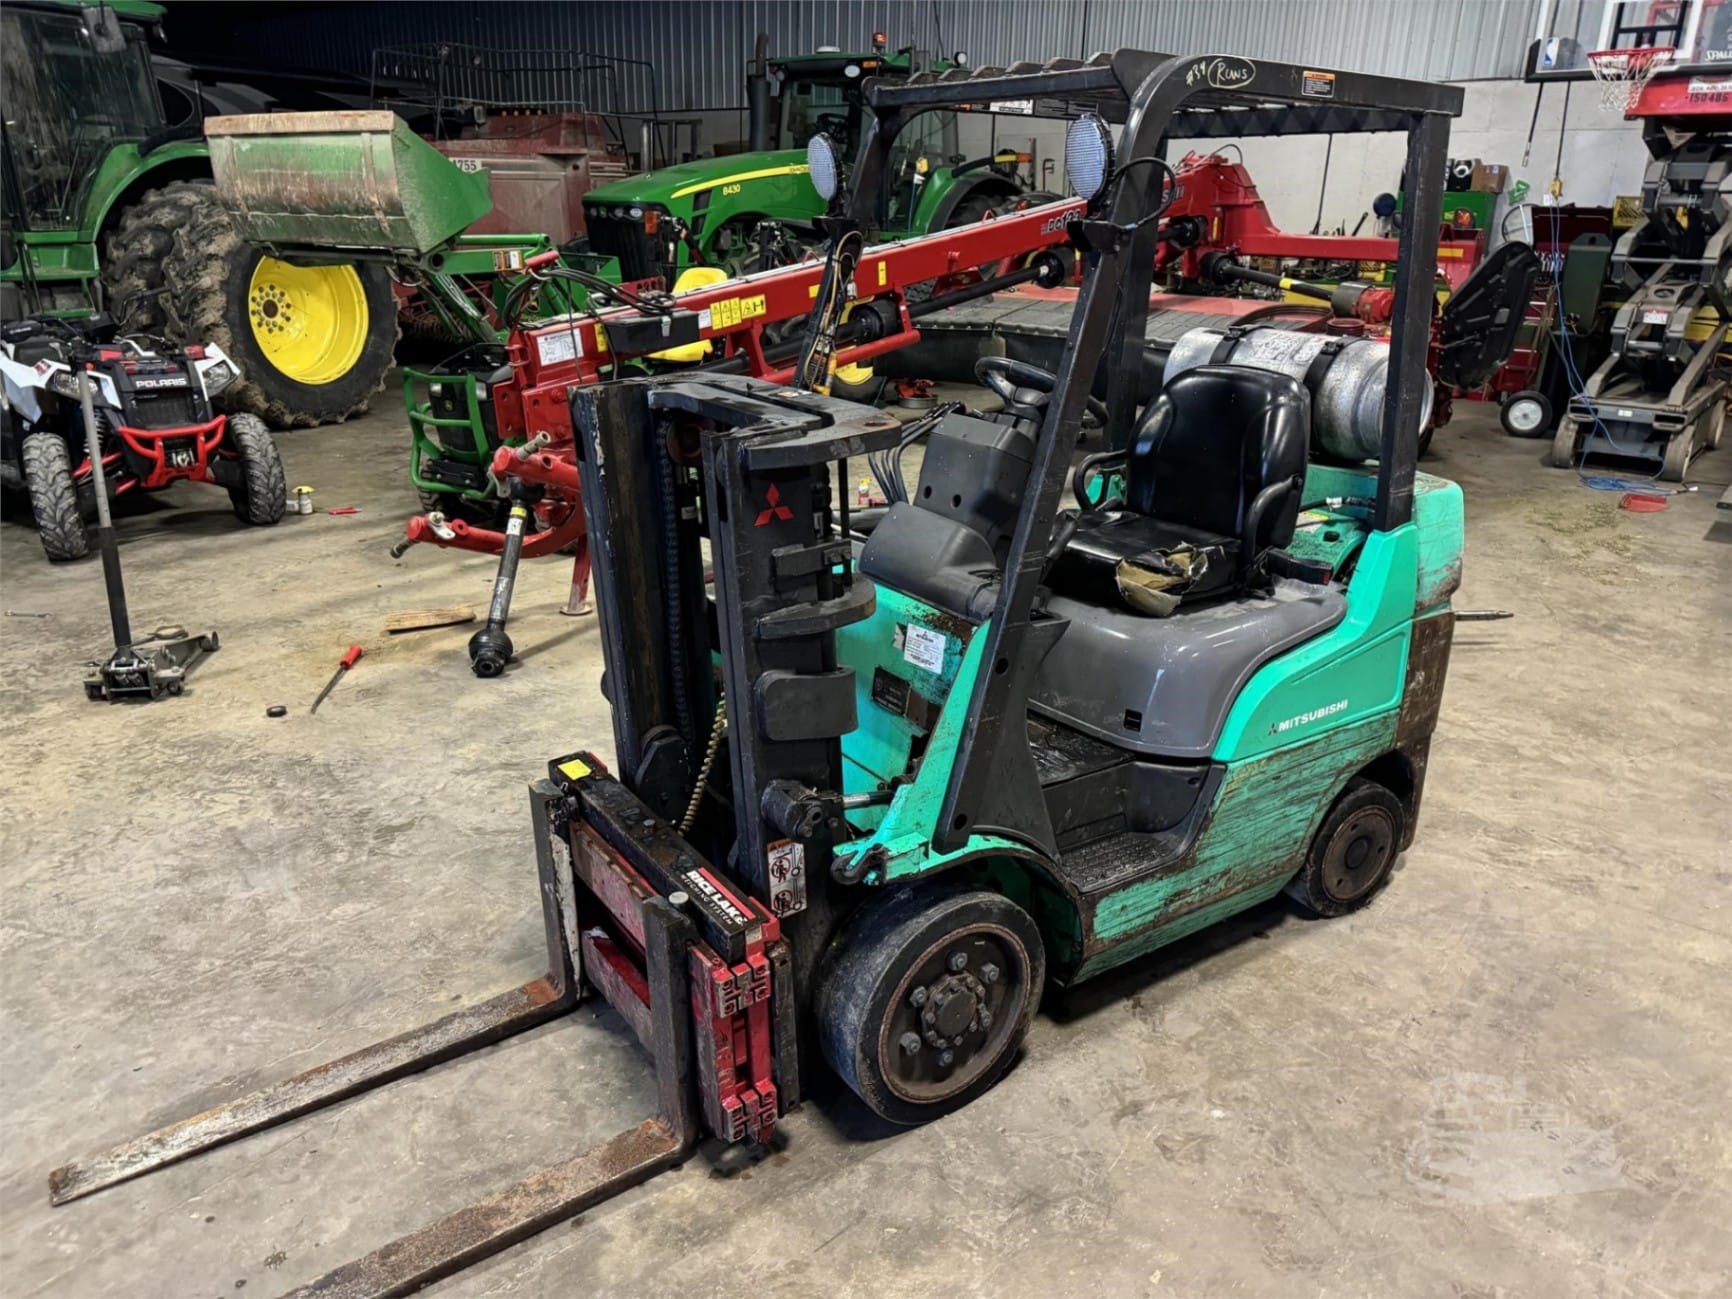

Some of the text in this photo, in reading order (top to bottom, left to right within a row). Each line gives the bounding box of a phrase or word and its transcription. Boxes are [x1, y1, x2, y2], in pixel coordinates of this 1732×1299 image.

[136, 378, 187, 388] POLARIS
[1278, 699, 1348, 732] MITSUBISHI
[686, 870, 717, 895] RICE
